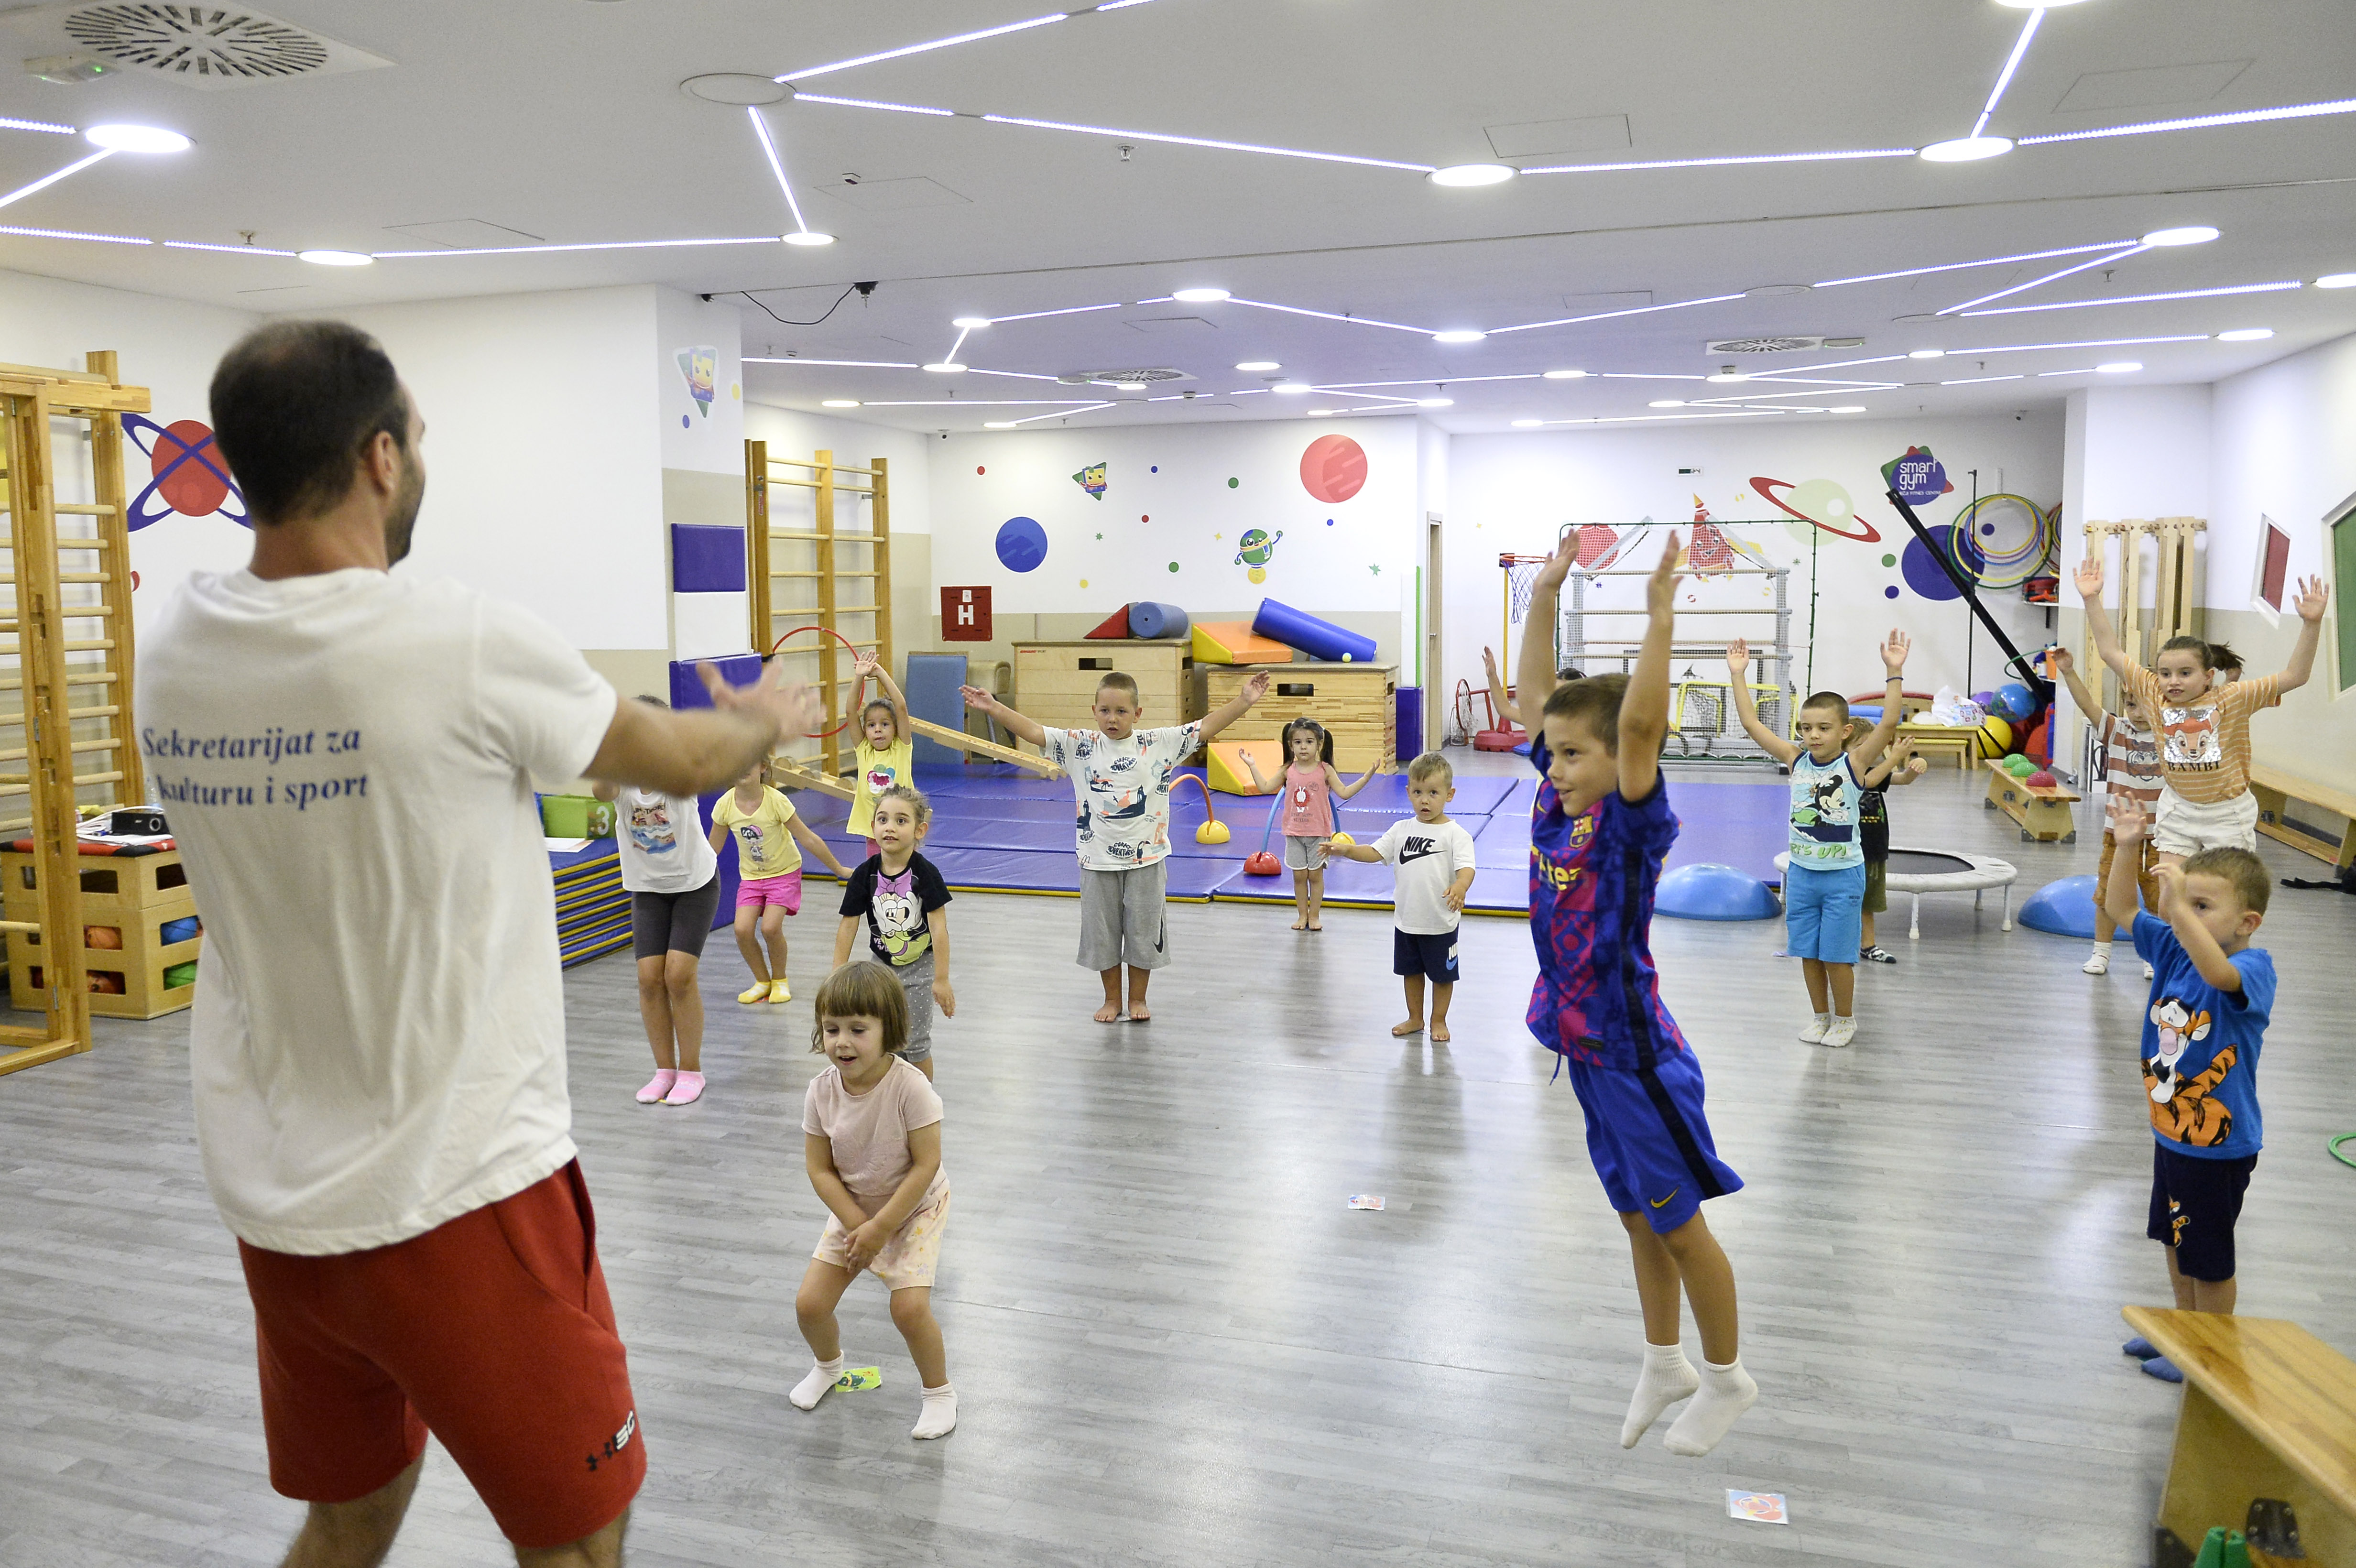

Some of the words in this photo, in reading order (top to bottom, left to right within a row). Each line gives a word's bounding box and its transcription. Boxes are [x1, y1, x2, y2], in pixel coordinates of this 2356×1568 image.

[1899, 458, 1938, 473] smart
[1899, 473, 1926, 490] gym
[958, 605, 974, 625] H
[143, 728, 315, 764] Sekretarijat
[327, 729, 361, 754] za
[2168, 761, 2219, 772] BAMBI
[156, 775, 253, 806] kulturu
[265, 777, 274, 804] i
[284, 774, 369, 811] sport
[596, 806, 610, 836] 3
[1404, 836, 1436, 853] NIKE
[1789, 843, 1812, 856] RF'S
[1817, 843, 1847, 859] UP!
